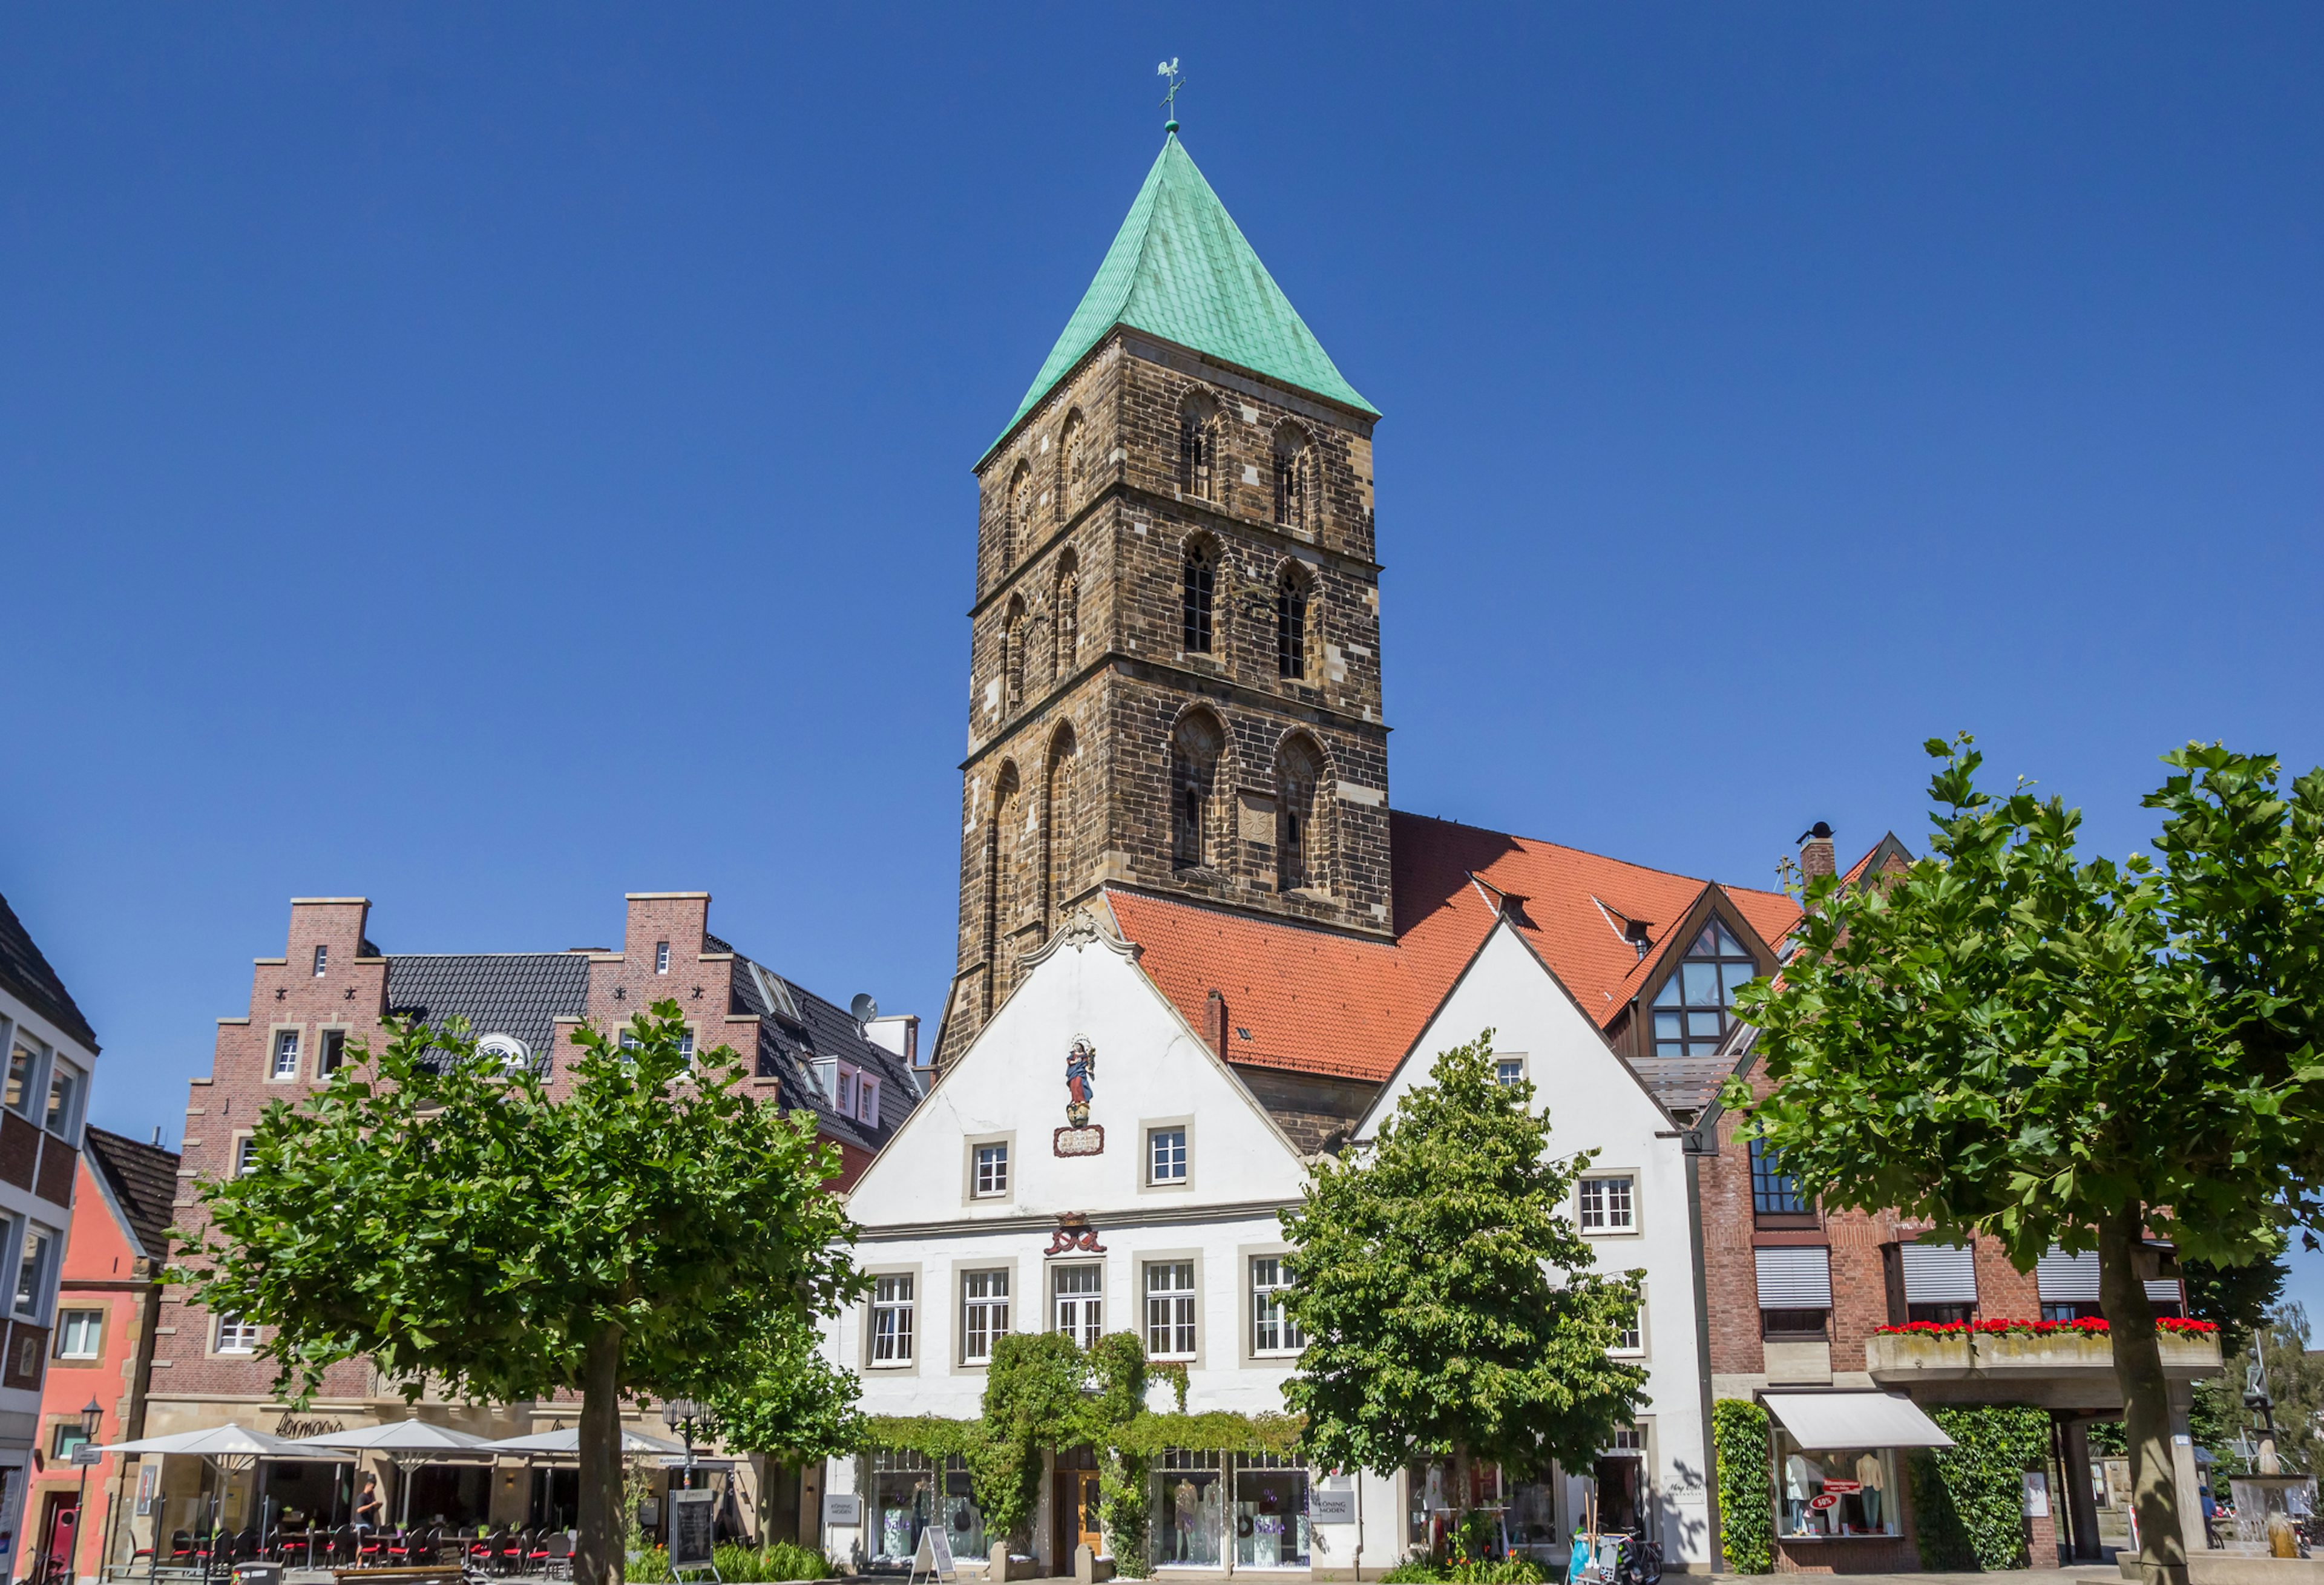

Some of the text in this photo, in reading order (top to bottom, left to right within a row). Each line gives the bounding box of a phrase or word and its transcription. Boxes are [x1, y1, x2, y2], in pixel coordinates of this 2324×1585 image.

[1817, 1497, 1832, 1508] 50%
[884, 1515, 910, 1531] Sale
[1255, 1518, 1285, 1535] Sale
